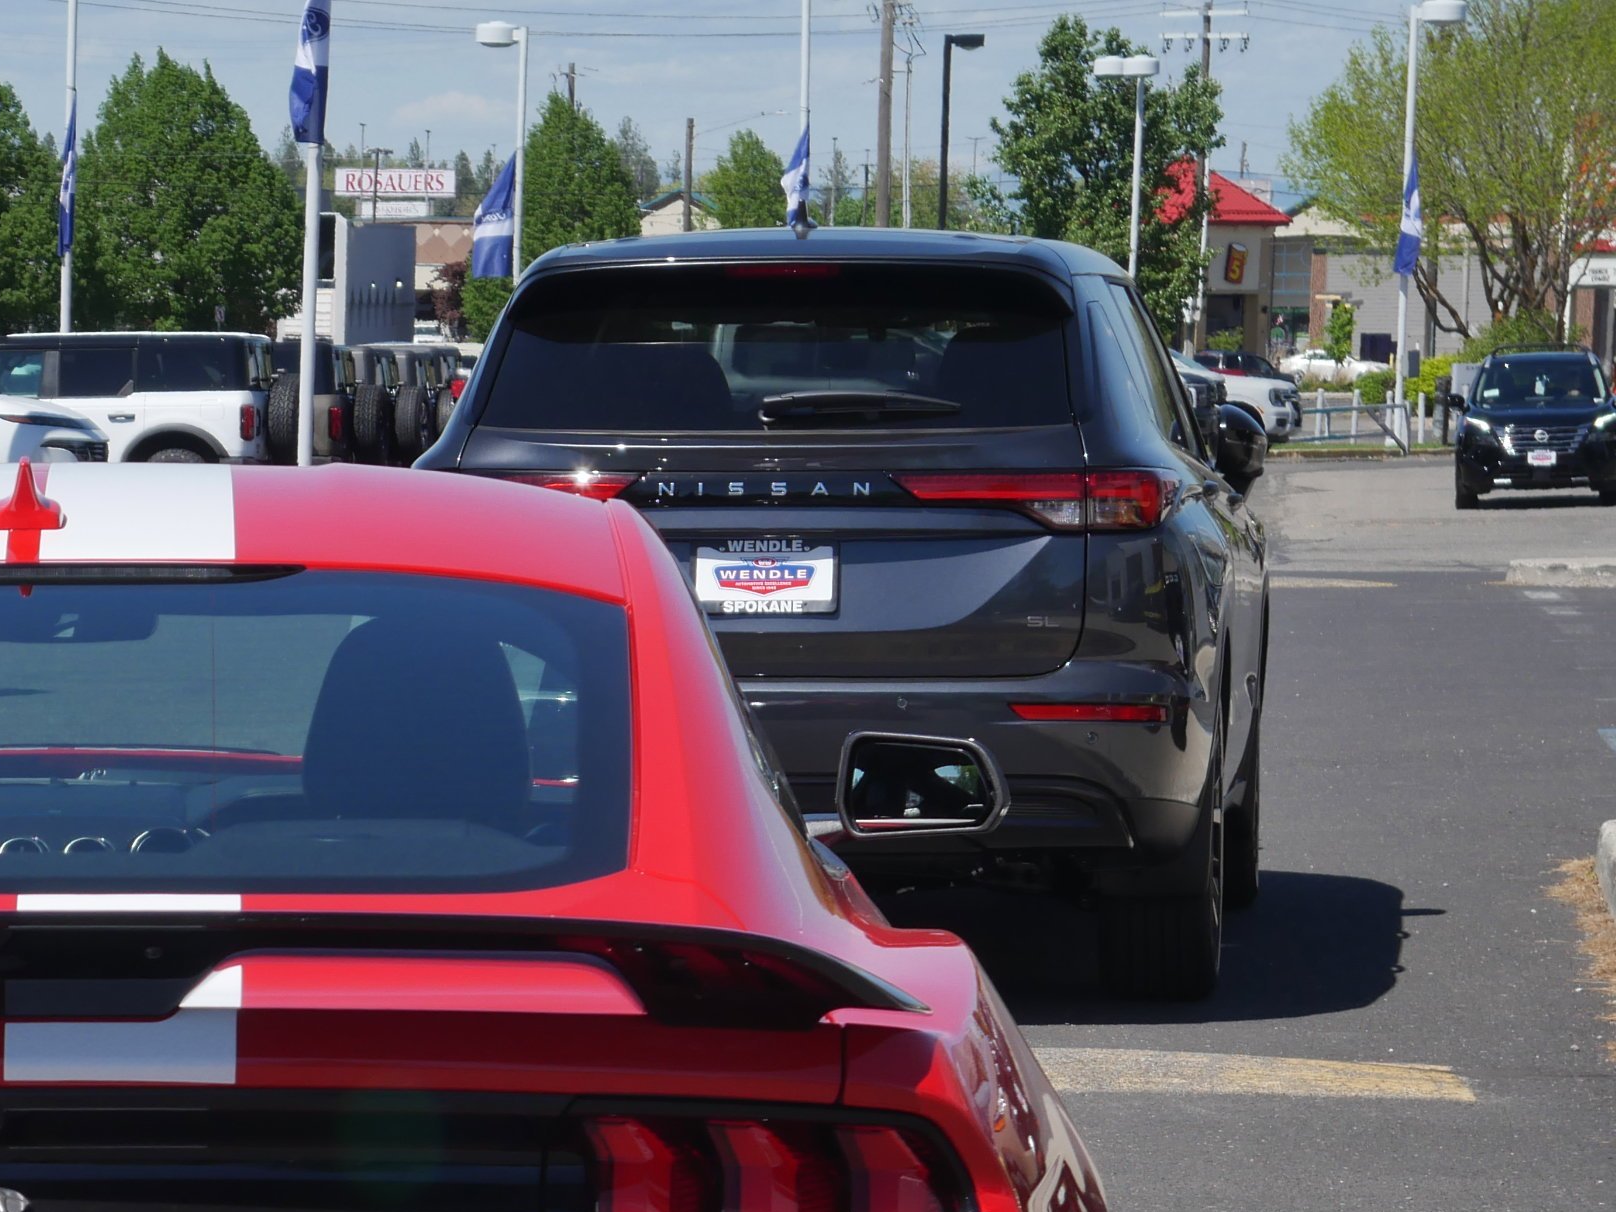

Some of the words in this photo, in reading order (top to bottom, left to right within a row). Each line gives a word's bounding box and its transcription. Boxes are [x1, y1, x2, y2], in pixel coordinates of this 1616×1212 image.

[346, 173, 444, 192] ROSAUERS
[658, 482, 870, 496] NISSAN
[727, 540, 803, 552] WENDLE
[719, 569, 808, 579] WENDLE
[722, 600, 803, 613] SPOKANE
[1026, 615, 1060, 628] SL
